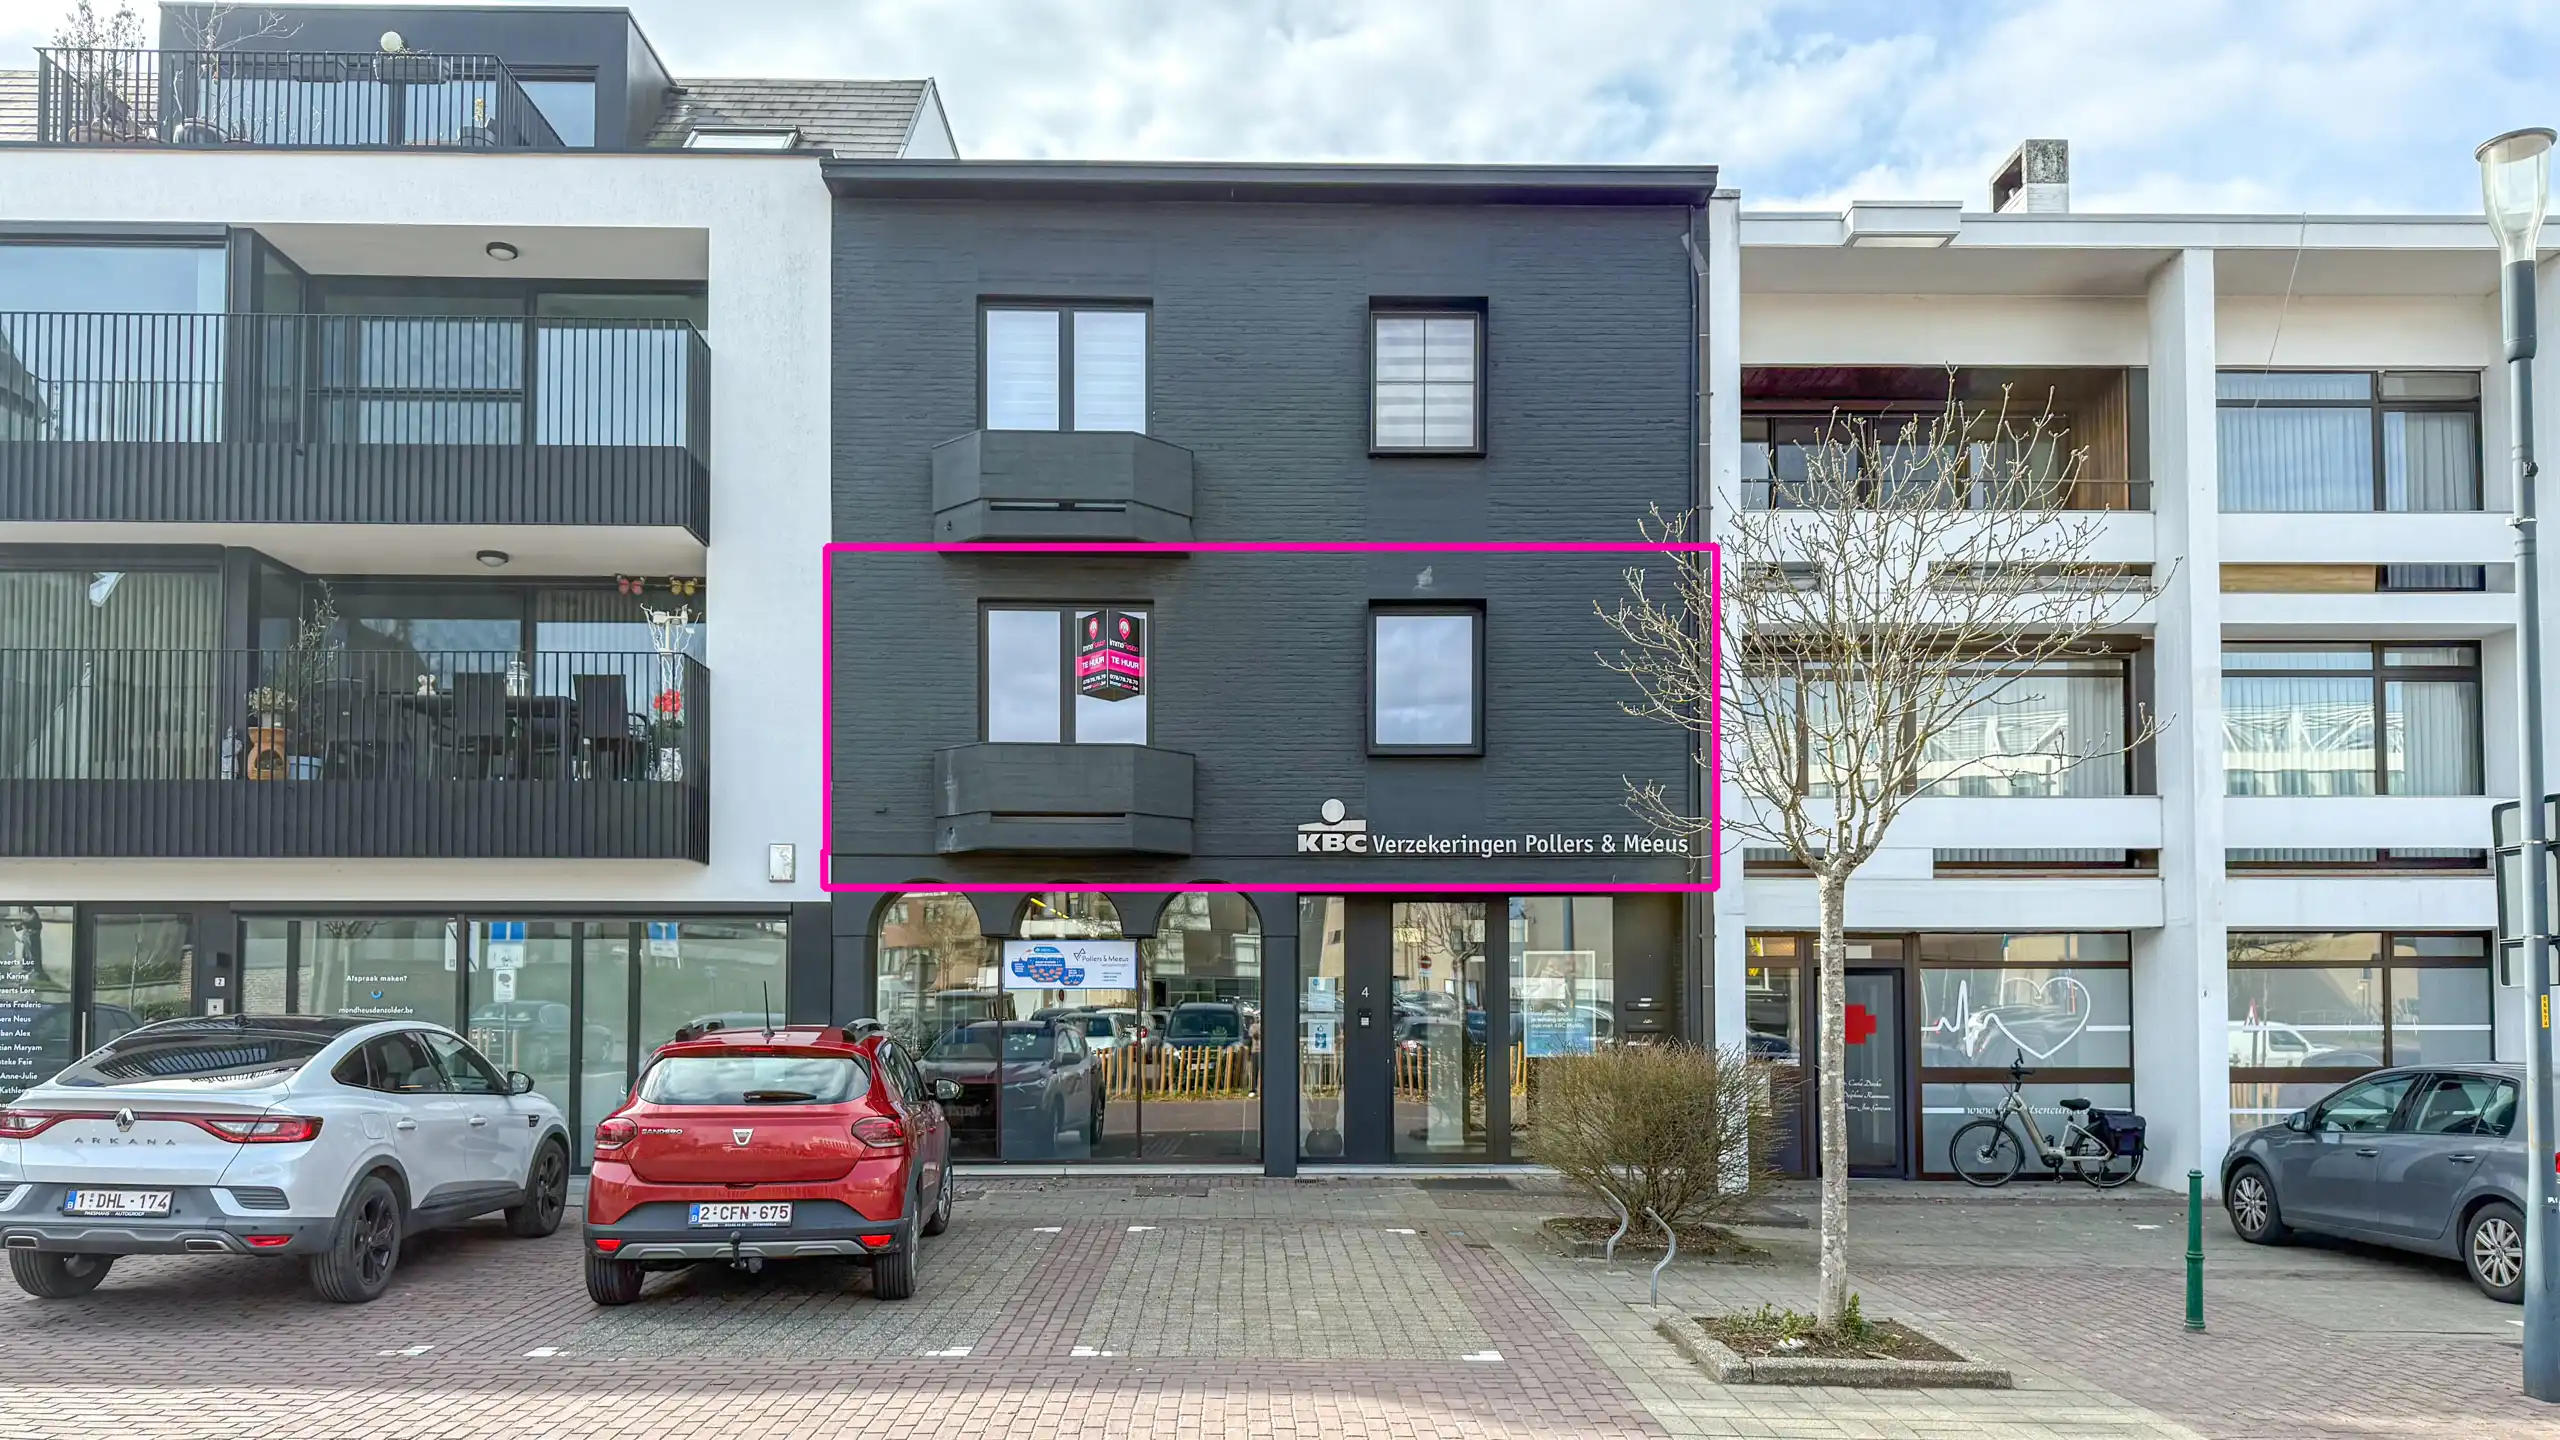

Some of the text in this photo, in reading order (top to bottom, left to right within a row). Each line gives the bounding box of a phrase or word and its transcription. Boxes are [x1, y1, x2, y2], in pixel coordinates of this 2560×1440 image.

[1082, 656, 1105, 669] TE HUUR
[1111, 656, 1139, 669] TE HUUR
[1298, 833, 1688, 858] KBC Verzekeringen Pollers & Meeus
[22, 958, 35, 966] Luc
[6, 971, 29, 980] Karine
[20, 986, 36, 994] Lore
[1361, 986, 1370, 998] 4
[13, 1000, 42, 1008] Frederic
[338, 1006, 414, 1014] mondheusdenzolder.be
[13, 1015, 31, 1023] Neus
[15, 1029, 31, 1037] Alex
[13, 1044, 43, 1054] Maryam
[0, 1072, 38, 1080] Anne-Julie
[0, 1086, 26, 1094] Kathlee
[74, 1137, 176, 1145] ARKANA
